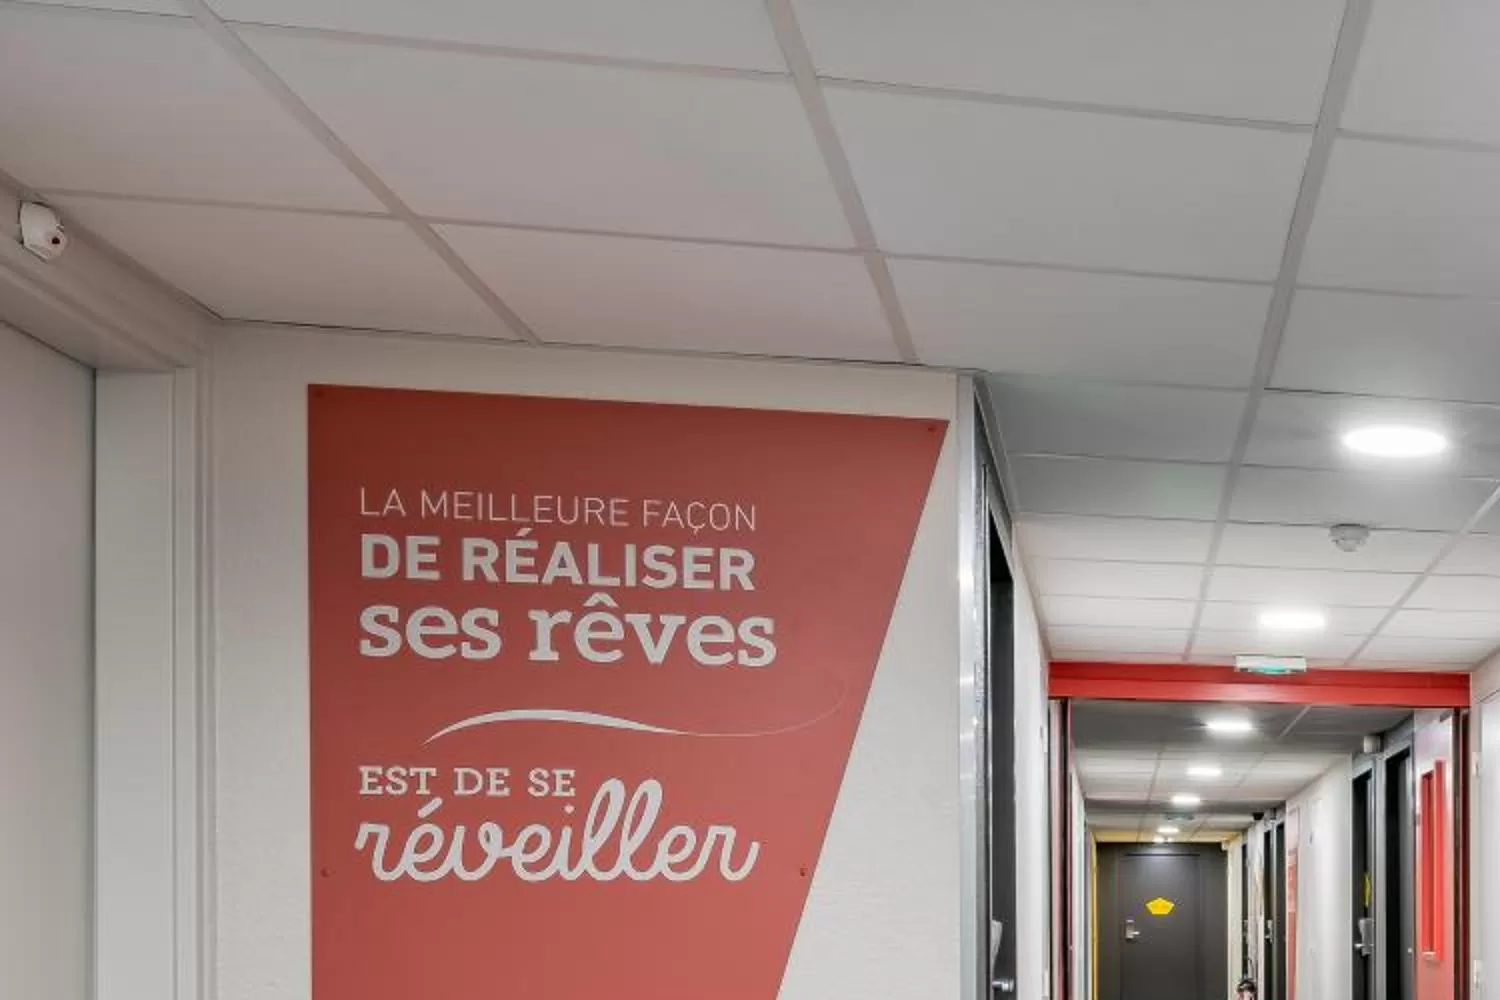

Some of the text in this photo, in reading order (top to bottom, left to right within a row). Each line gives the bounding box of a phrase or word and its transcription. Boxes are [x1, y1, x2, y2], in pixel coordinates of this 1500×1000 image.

[359, 487, 756, 536] LA MEILLEURE FAÇON
[360, 527, 756, 592] DE RÉALISER
[359, 592, 777, 667] ses rêves
[358, 765, 577, 798] EST DE SE
[354, 778, 761, 882] réveiller
